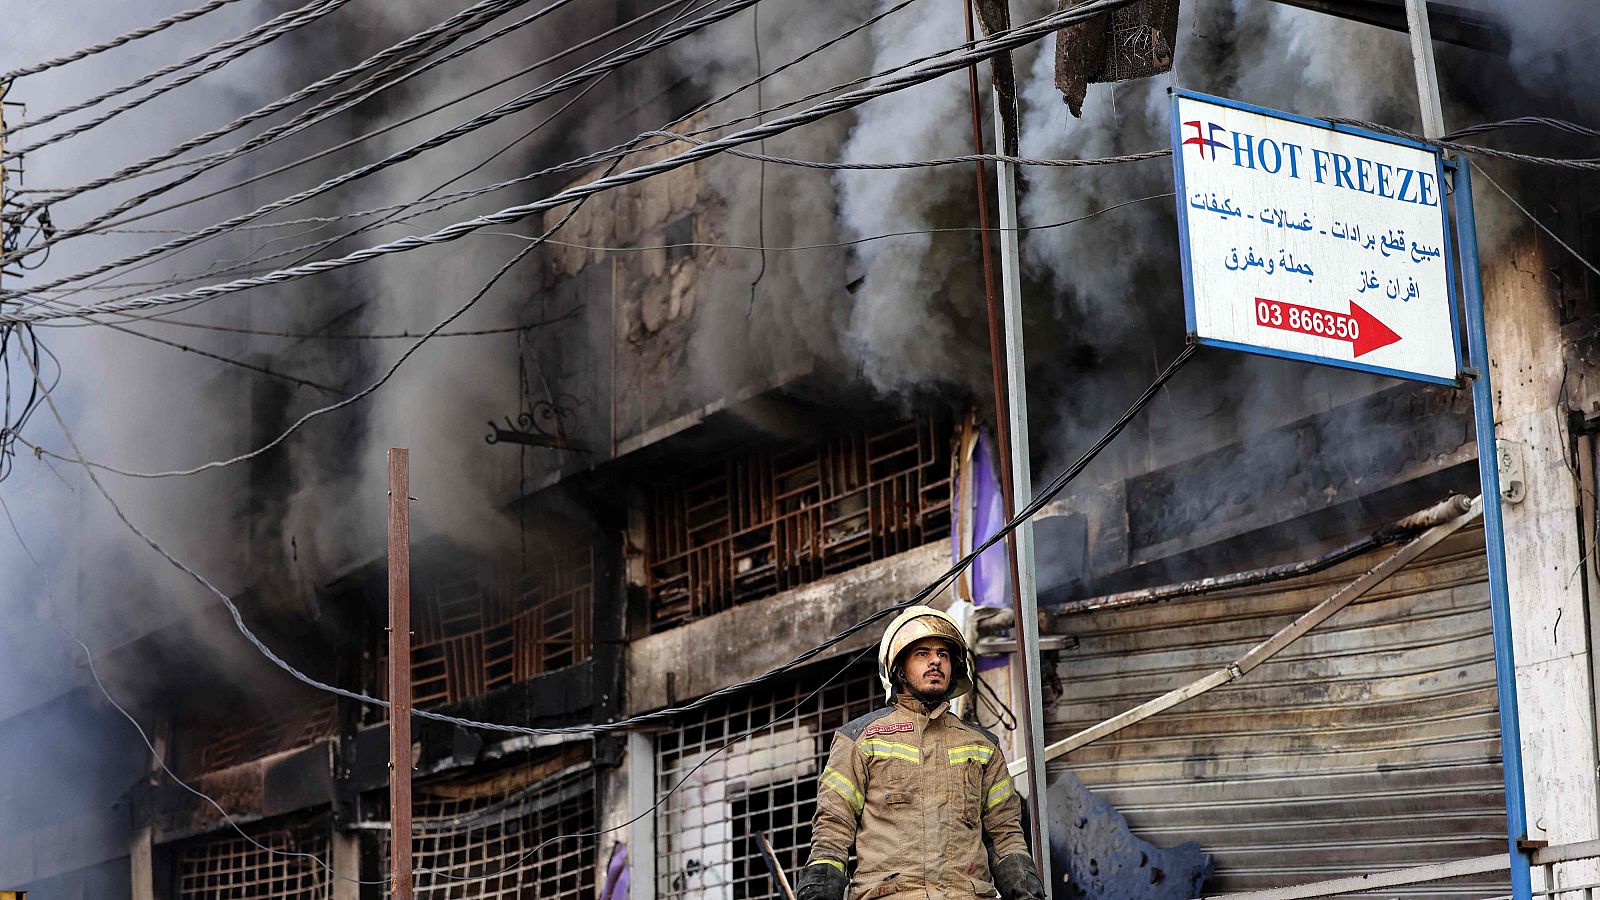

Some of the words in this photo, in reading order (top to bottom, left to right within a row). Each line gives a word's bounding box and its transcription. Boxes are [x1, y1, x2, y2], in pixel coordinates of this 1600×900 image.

[1230, 131, 1303, 179] HOT
[1311, 148, 1438, 207] FREEZE
[1190, 193, 1242, 220] مكيفات
[1260, 209, 1314, 232] غسالات
[1332, 221, 1376, 250] برادات
[1381, 230, 1406, 257] قطع
[1225, 246, 1275, 275] ومفرق
[1279, 248, 1314, 284] جملة
[1411, 241, 1441, 264] مبيع
[1357, 270, 1380, 294] غاز
[1386, 277, 1420, 303] افران
[1257, 302, 1283, 326] 03
[1288, 308, 1360, 340] 866350
